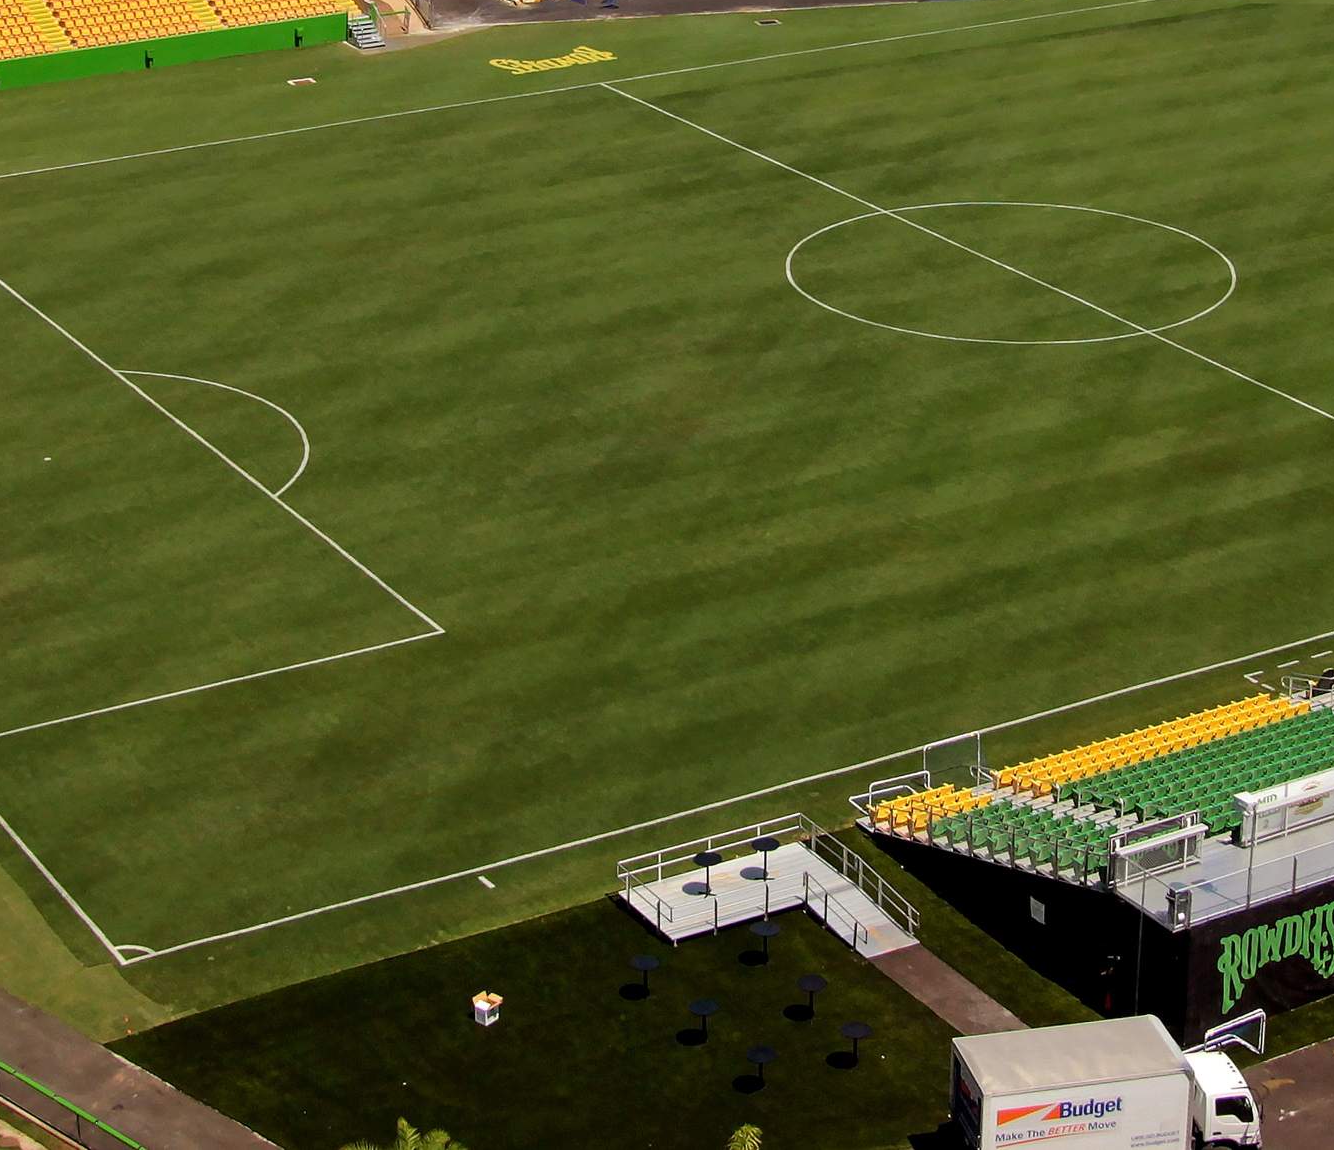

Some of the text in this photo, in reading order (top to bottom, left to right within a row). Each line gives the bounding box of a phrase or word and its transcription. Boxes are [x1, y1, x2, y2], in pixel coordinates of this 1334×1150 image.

[1059, 1096, 1123, 1120] Budget
[995, 1119, 1117, 1143] Make The BETTER Move
